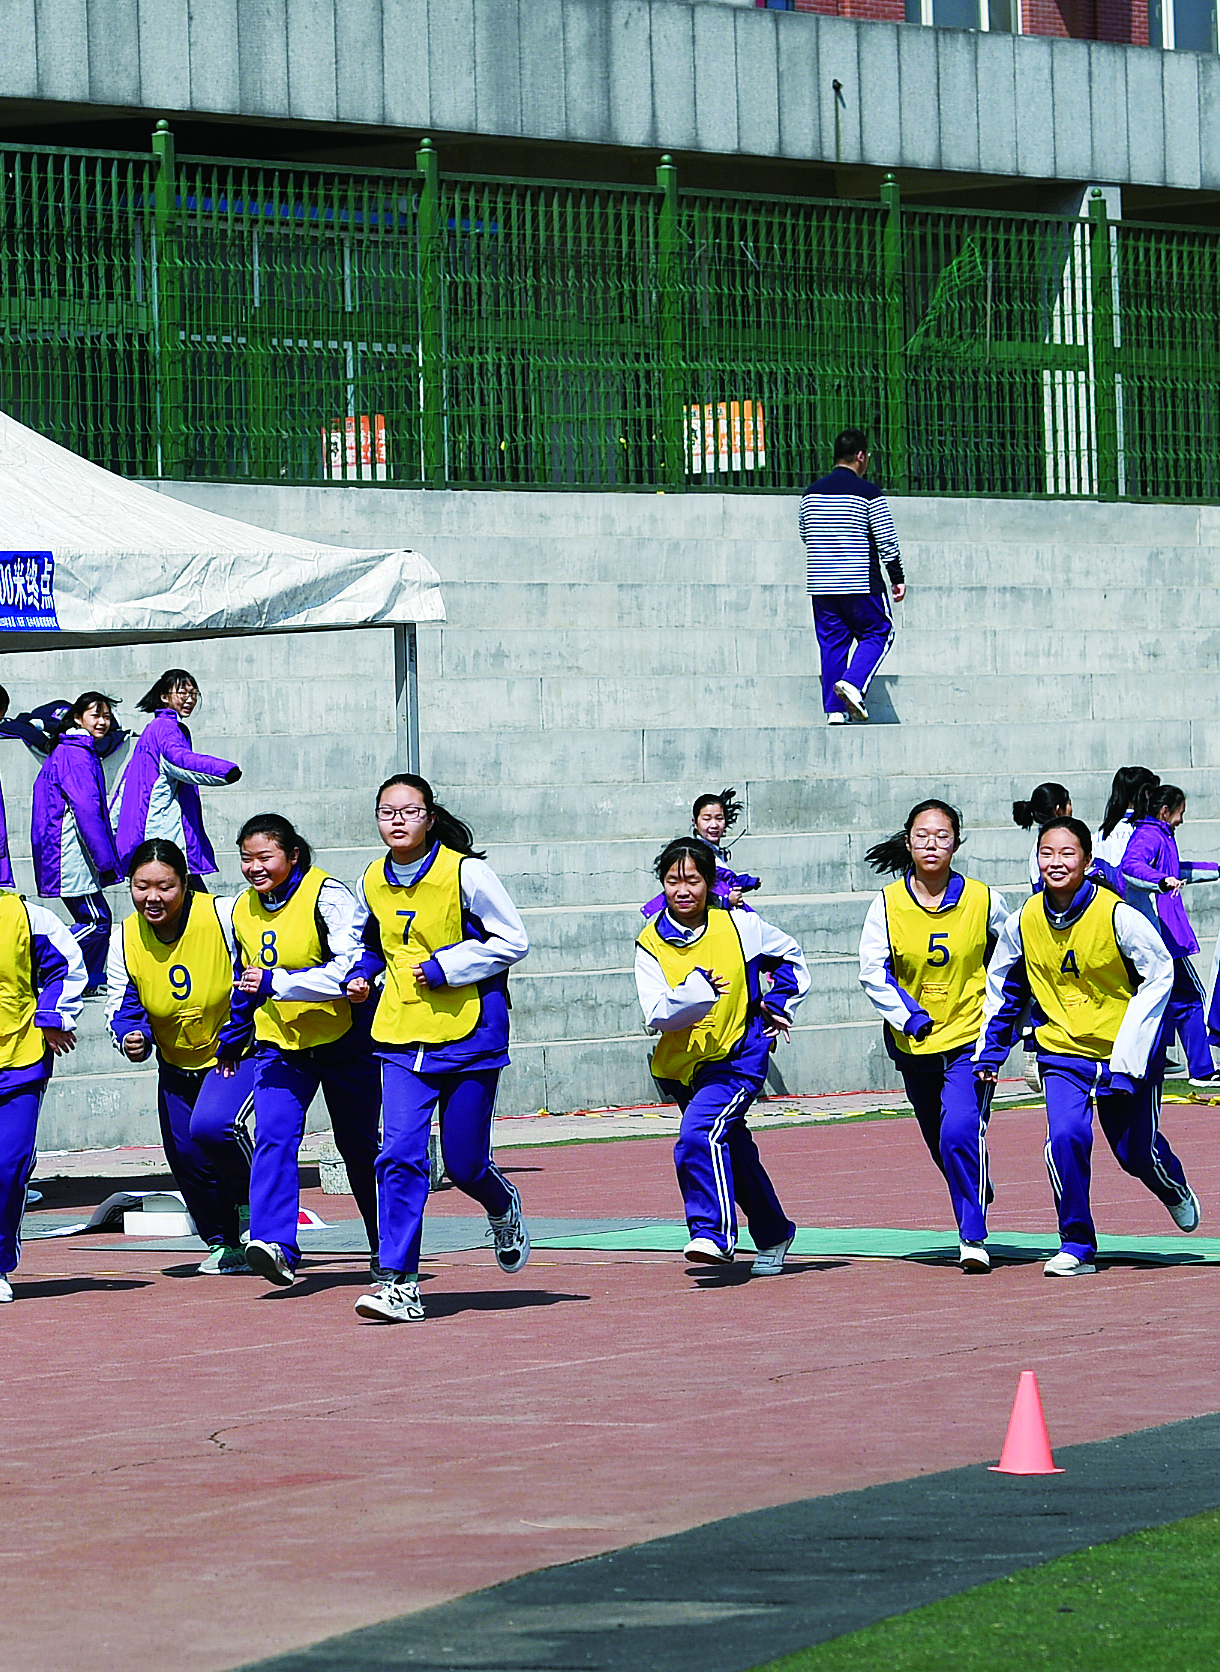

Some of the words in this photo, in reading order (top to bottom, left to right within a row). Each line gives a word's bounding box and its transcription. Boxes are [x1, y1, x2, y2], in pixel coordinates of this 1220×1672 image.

[396, 911, 416, 945] 7
[261, 931, 277, 967] 8
[927, 933, 950, 967] 5
[1060, 949, 1080, 979] 4
[169, 965, 191, 1000] 9
